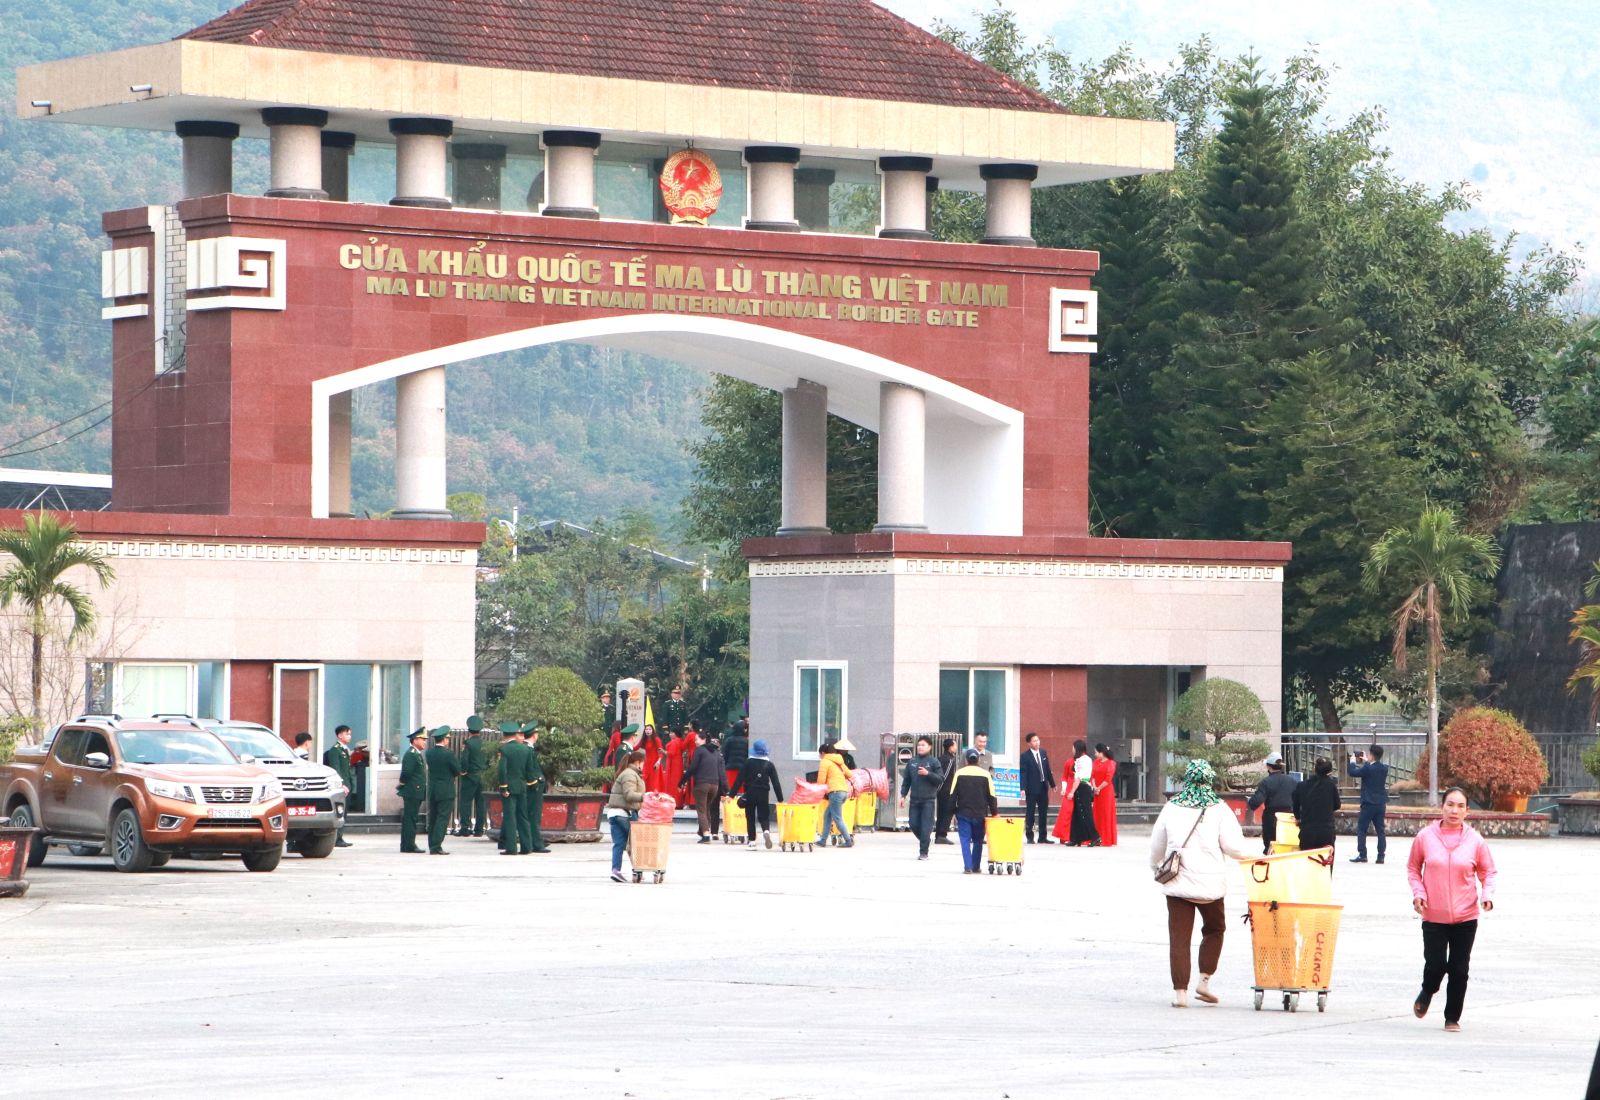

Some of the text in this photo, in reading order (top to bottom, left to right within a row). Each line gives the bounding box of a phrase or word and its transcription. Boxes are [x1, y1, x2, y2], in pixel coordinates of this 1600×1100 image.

[339, 236, 1009, 308] CỬA KHẨU QUỐC TẾ MA LÙ THÀNG VIỆT NAM
[366, 276, 979, 328] MA LU THANG VIETNAM INTERNATIONAL BORDER GATE
